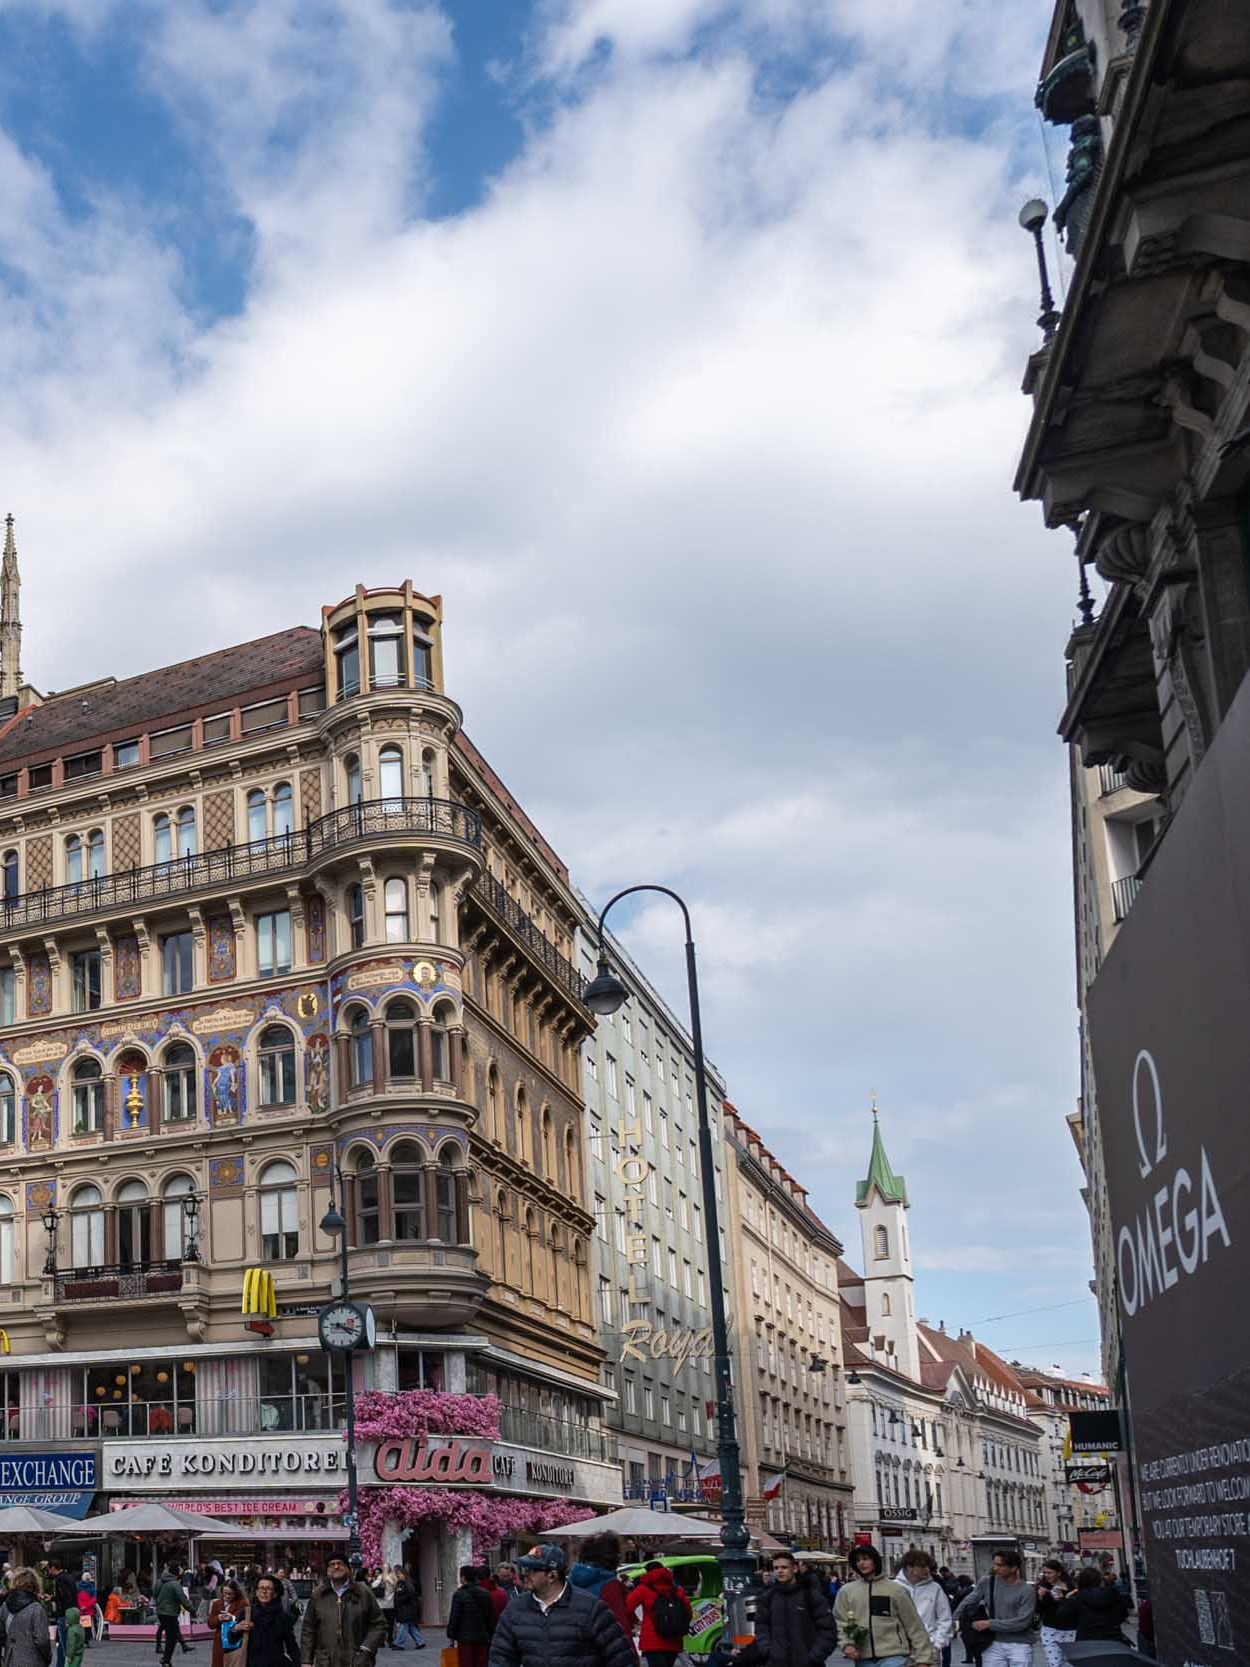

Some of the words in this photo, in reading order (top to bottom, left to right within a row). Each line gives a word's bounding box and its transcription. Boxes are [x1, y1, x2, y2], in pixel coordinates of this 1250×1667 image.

[617, 1119, 652, 1304] HOTEL
[1117, 1143, 1231, 1316] OMEGA
[1074, 1441, 1119, 1451] HUMANIC
[1208, 1438, 1250, 1469] RENOVATIO
[1, 1459, 95, 1487] EXCHANGE
[34, 1492, 81, 1504] GROUP
[1215, 1476, 1250, 1501] WELCOM
[215, 1503, 238, 1513] BEST
[242, 1503, 260, 1512] ICE
[262, 1502, 297, 1512] CREAM
[884, 1509, 912, 1517] OSSIG
